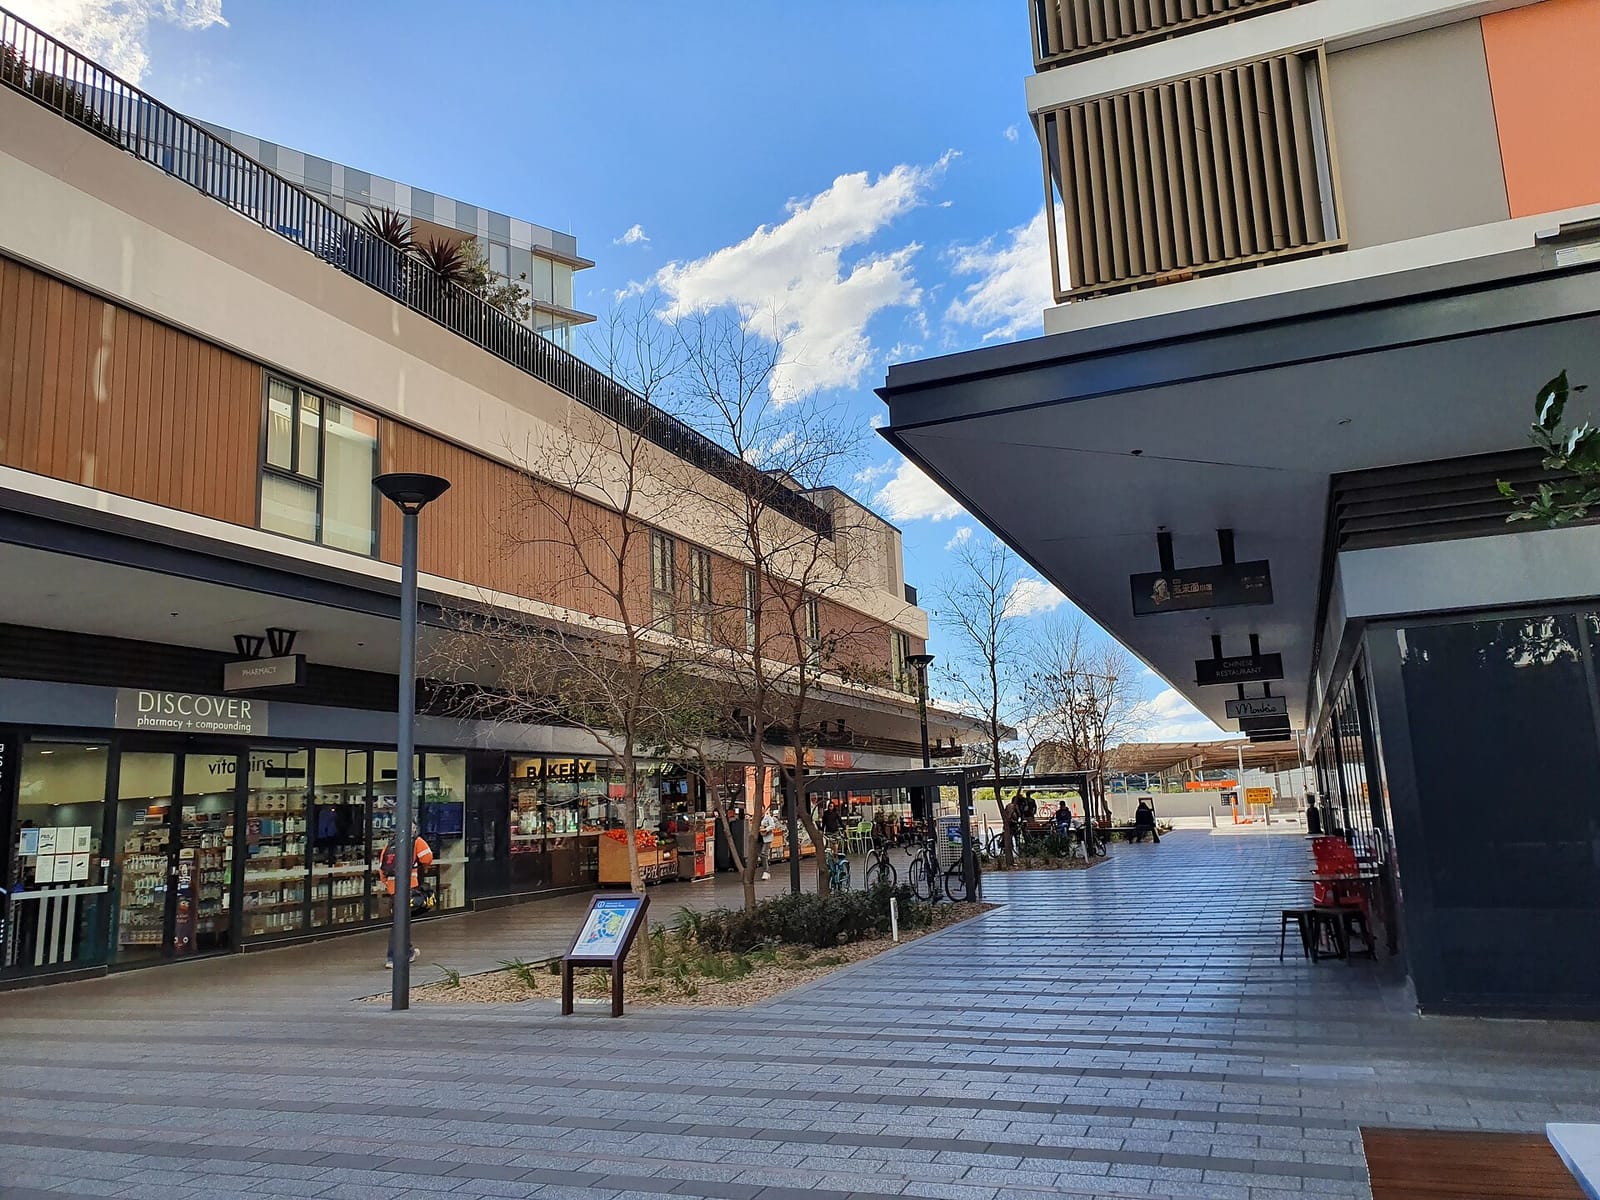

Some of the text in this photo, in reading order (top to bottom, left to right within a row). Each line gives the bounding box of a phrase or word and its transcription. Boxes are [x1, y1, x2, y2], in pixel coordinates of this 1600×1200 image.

[241, 666, 278, 677] PHARMACY
[1215, 667, 1262, 677] RESTAURANT
[138, 692, 251, 719] DISCOVER
[137, 715, 183, 729] pharmacy
[195, 720, 251, 734] compounding
[208, 756, 274, 774] vitains
[526, 761, 592, 779] BKERY
